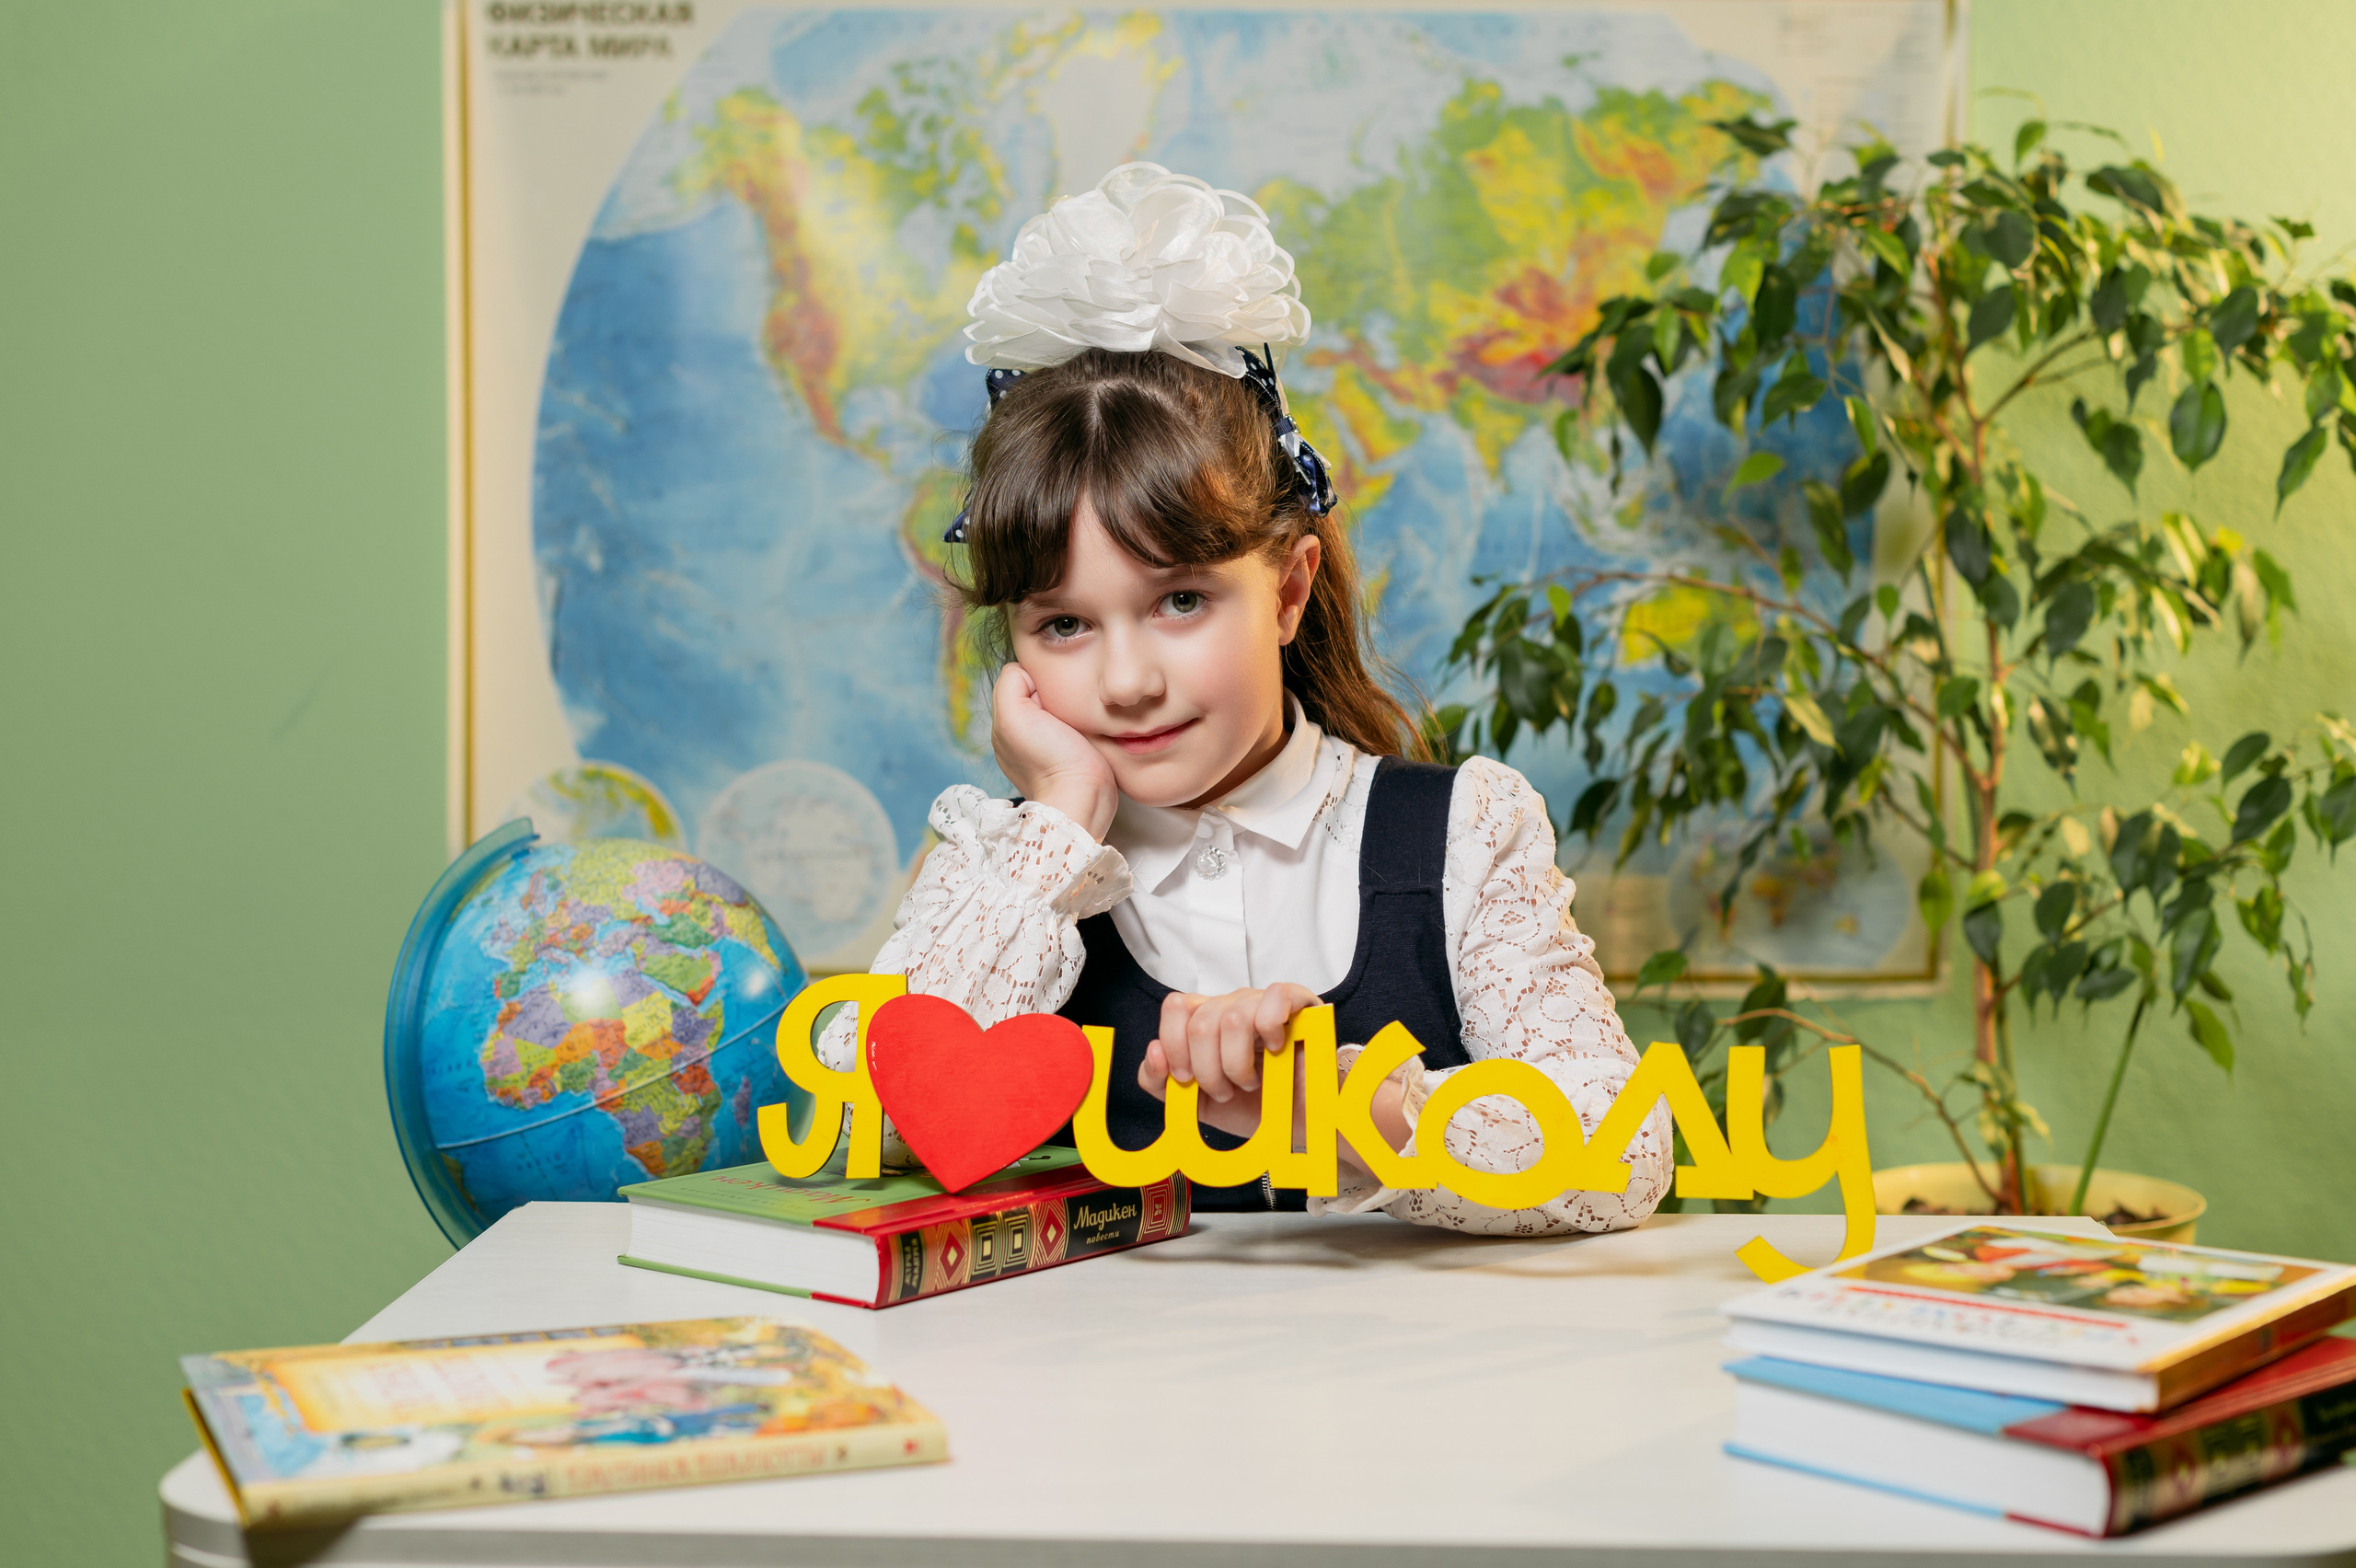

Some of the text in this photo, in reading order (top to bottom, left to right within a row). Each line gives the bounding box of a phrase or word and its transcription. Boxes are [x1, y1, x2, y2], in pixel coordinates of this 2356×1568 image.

[487, 33, 674, 59] КАРТА МИРА
[756, 973, 908, 1180] Я
[1073, 1202, 1138, 1231] Мадикен
[1086, 1230, 1120, 1245] повести
